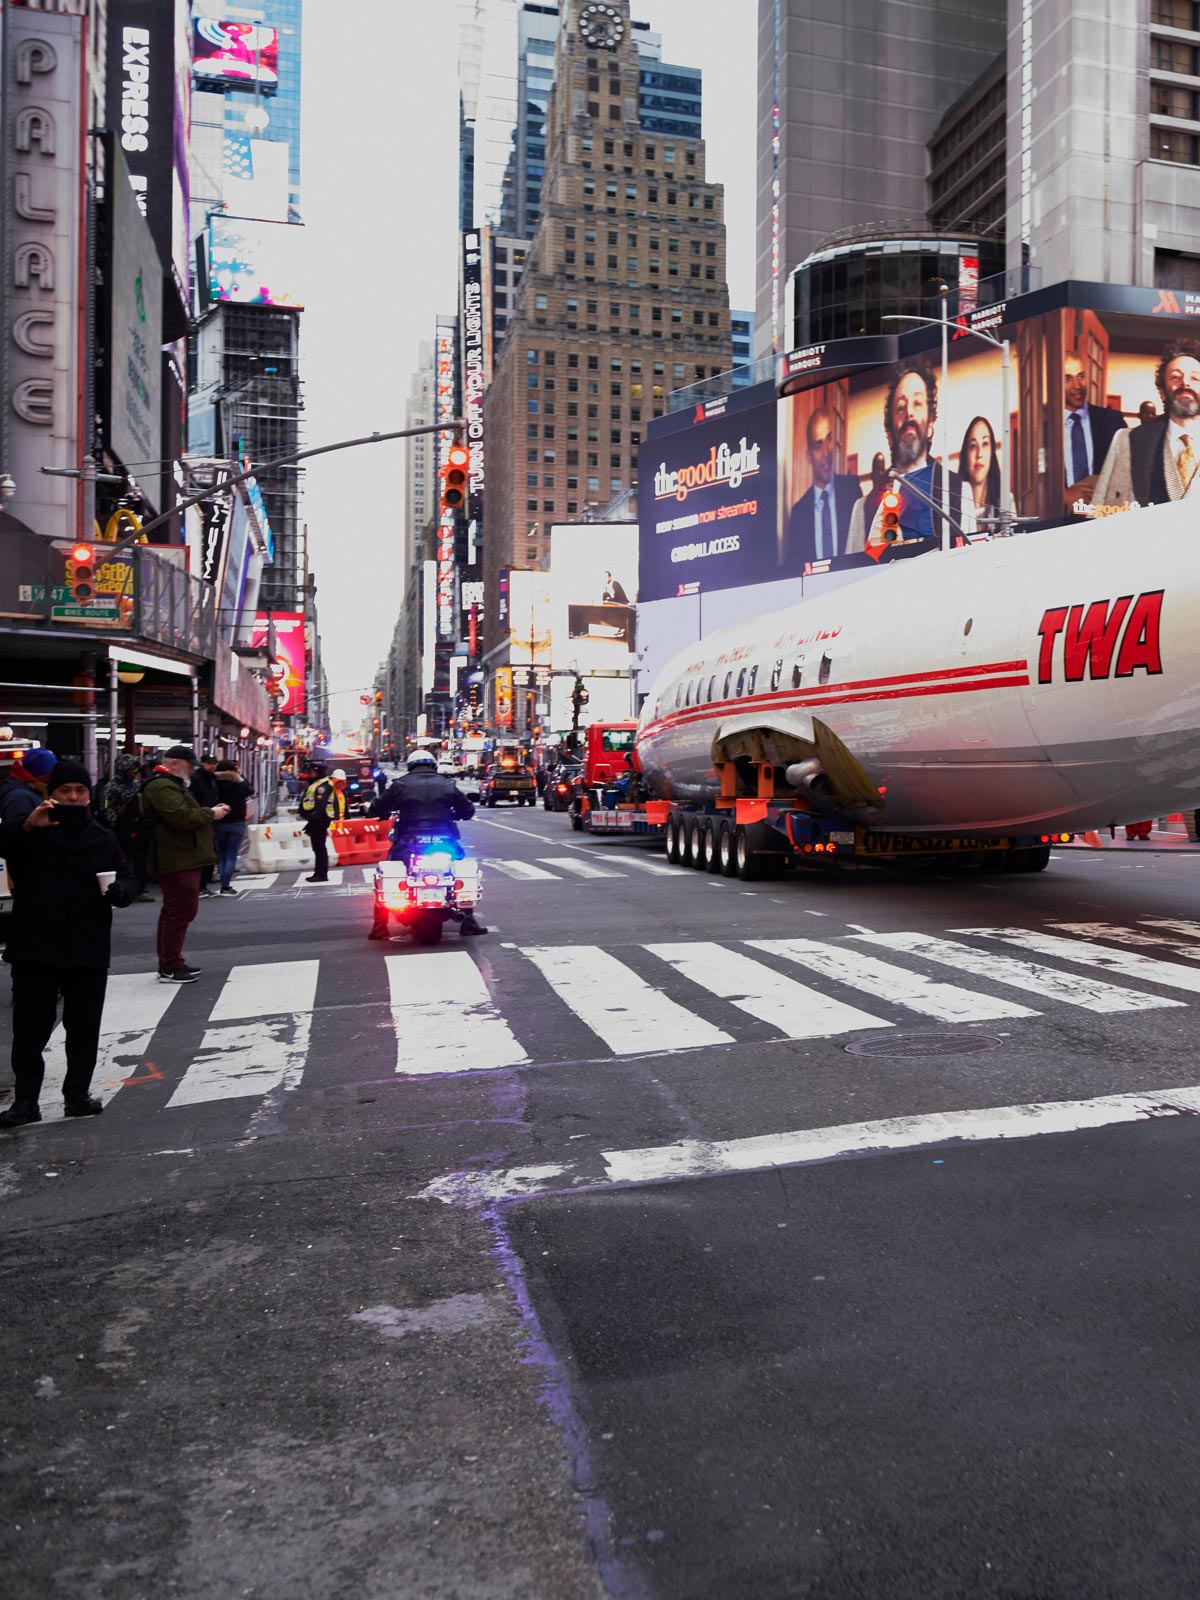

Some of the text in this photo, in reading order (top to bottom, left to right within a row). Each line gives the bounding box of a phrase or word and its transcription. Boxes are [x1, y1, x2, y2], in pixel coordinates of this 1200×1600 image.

[121, 27, 149, 152] EXPRESS
[13, 37, 58, 425] PALACE
[465, 282, 482, 346] LIGHTS
[466, 347, 484, 403] YOUR
[467, 404, 484, 438] OFF
[467, 441, 485, 493] TURN
[717, 499, 758, 520] streaming
[50, 586, 63, 600] 47
[85, 609, 110, 617] ROUTE
[1037, 589, 1166, 685] TWA
